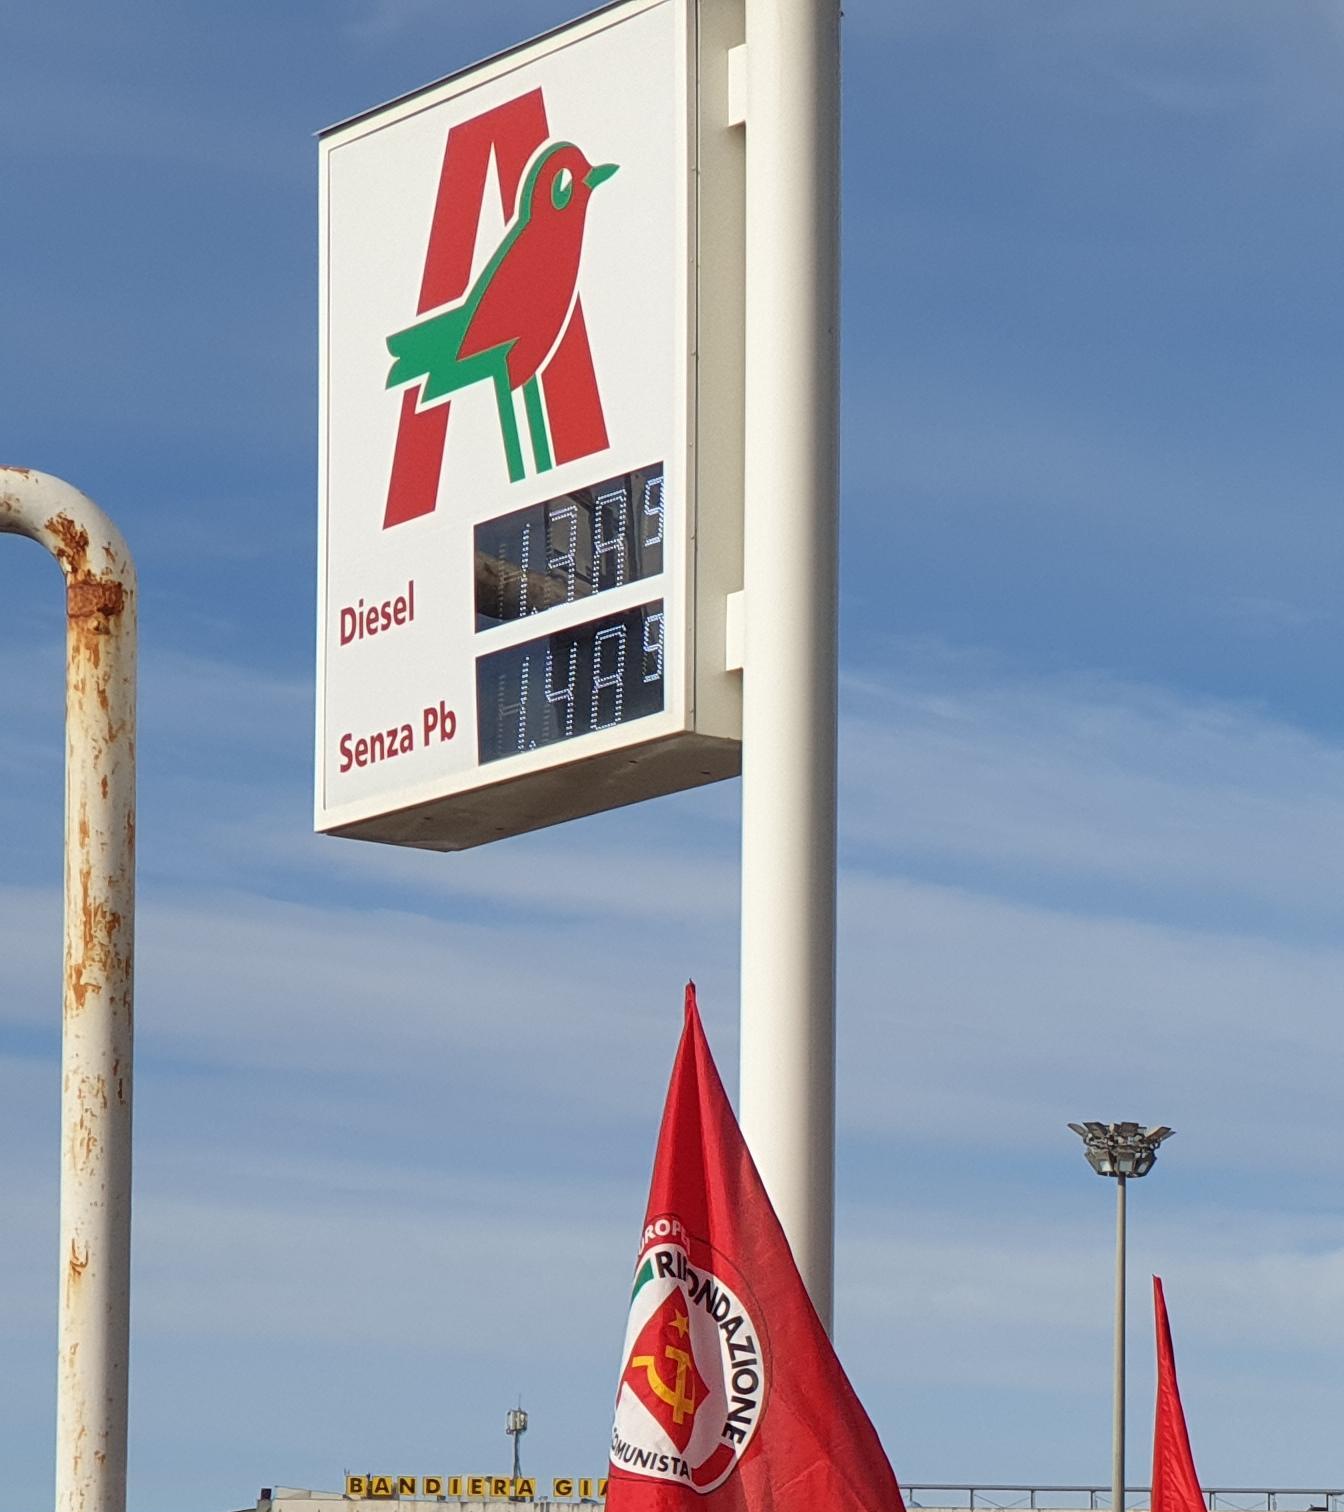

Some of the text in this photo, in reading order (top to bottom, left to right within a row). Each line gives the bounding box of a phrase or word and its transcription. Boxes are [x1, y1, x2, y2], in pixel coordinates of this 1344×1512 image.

[340, 579, 414, 647] Diesel
[339, 700, 457, 774] Senza Pb
[611, 1427, 691, 1481] OMUNISTA
[349, 1476, 535, 1495] BANDIERA
